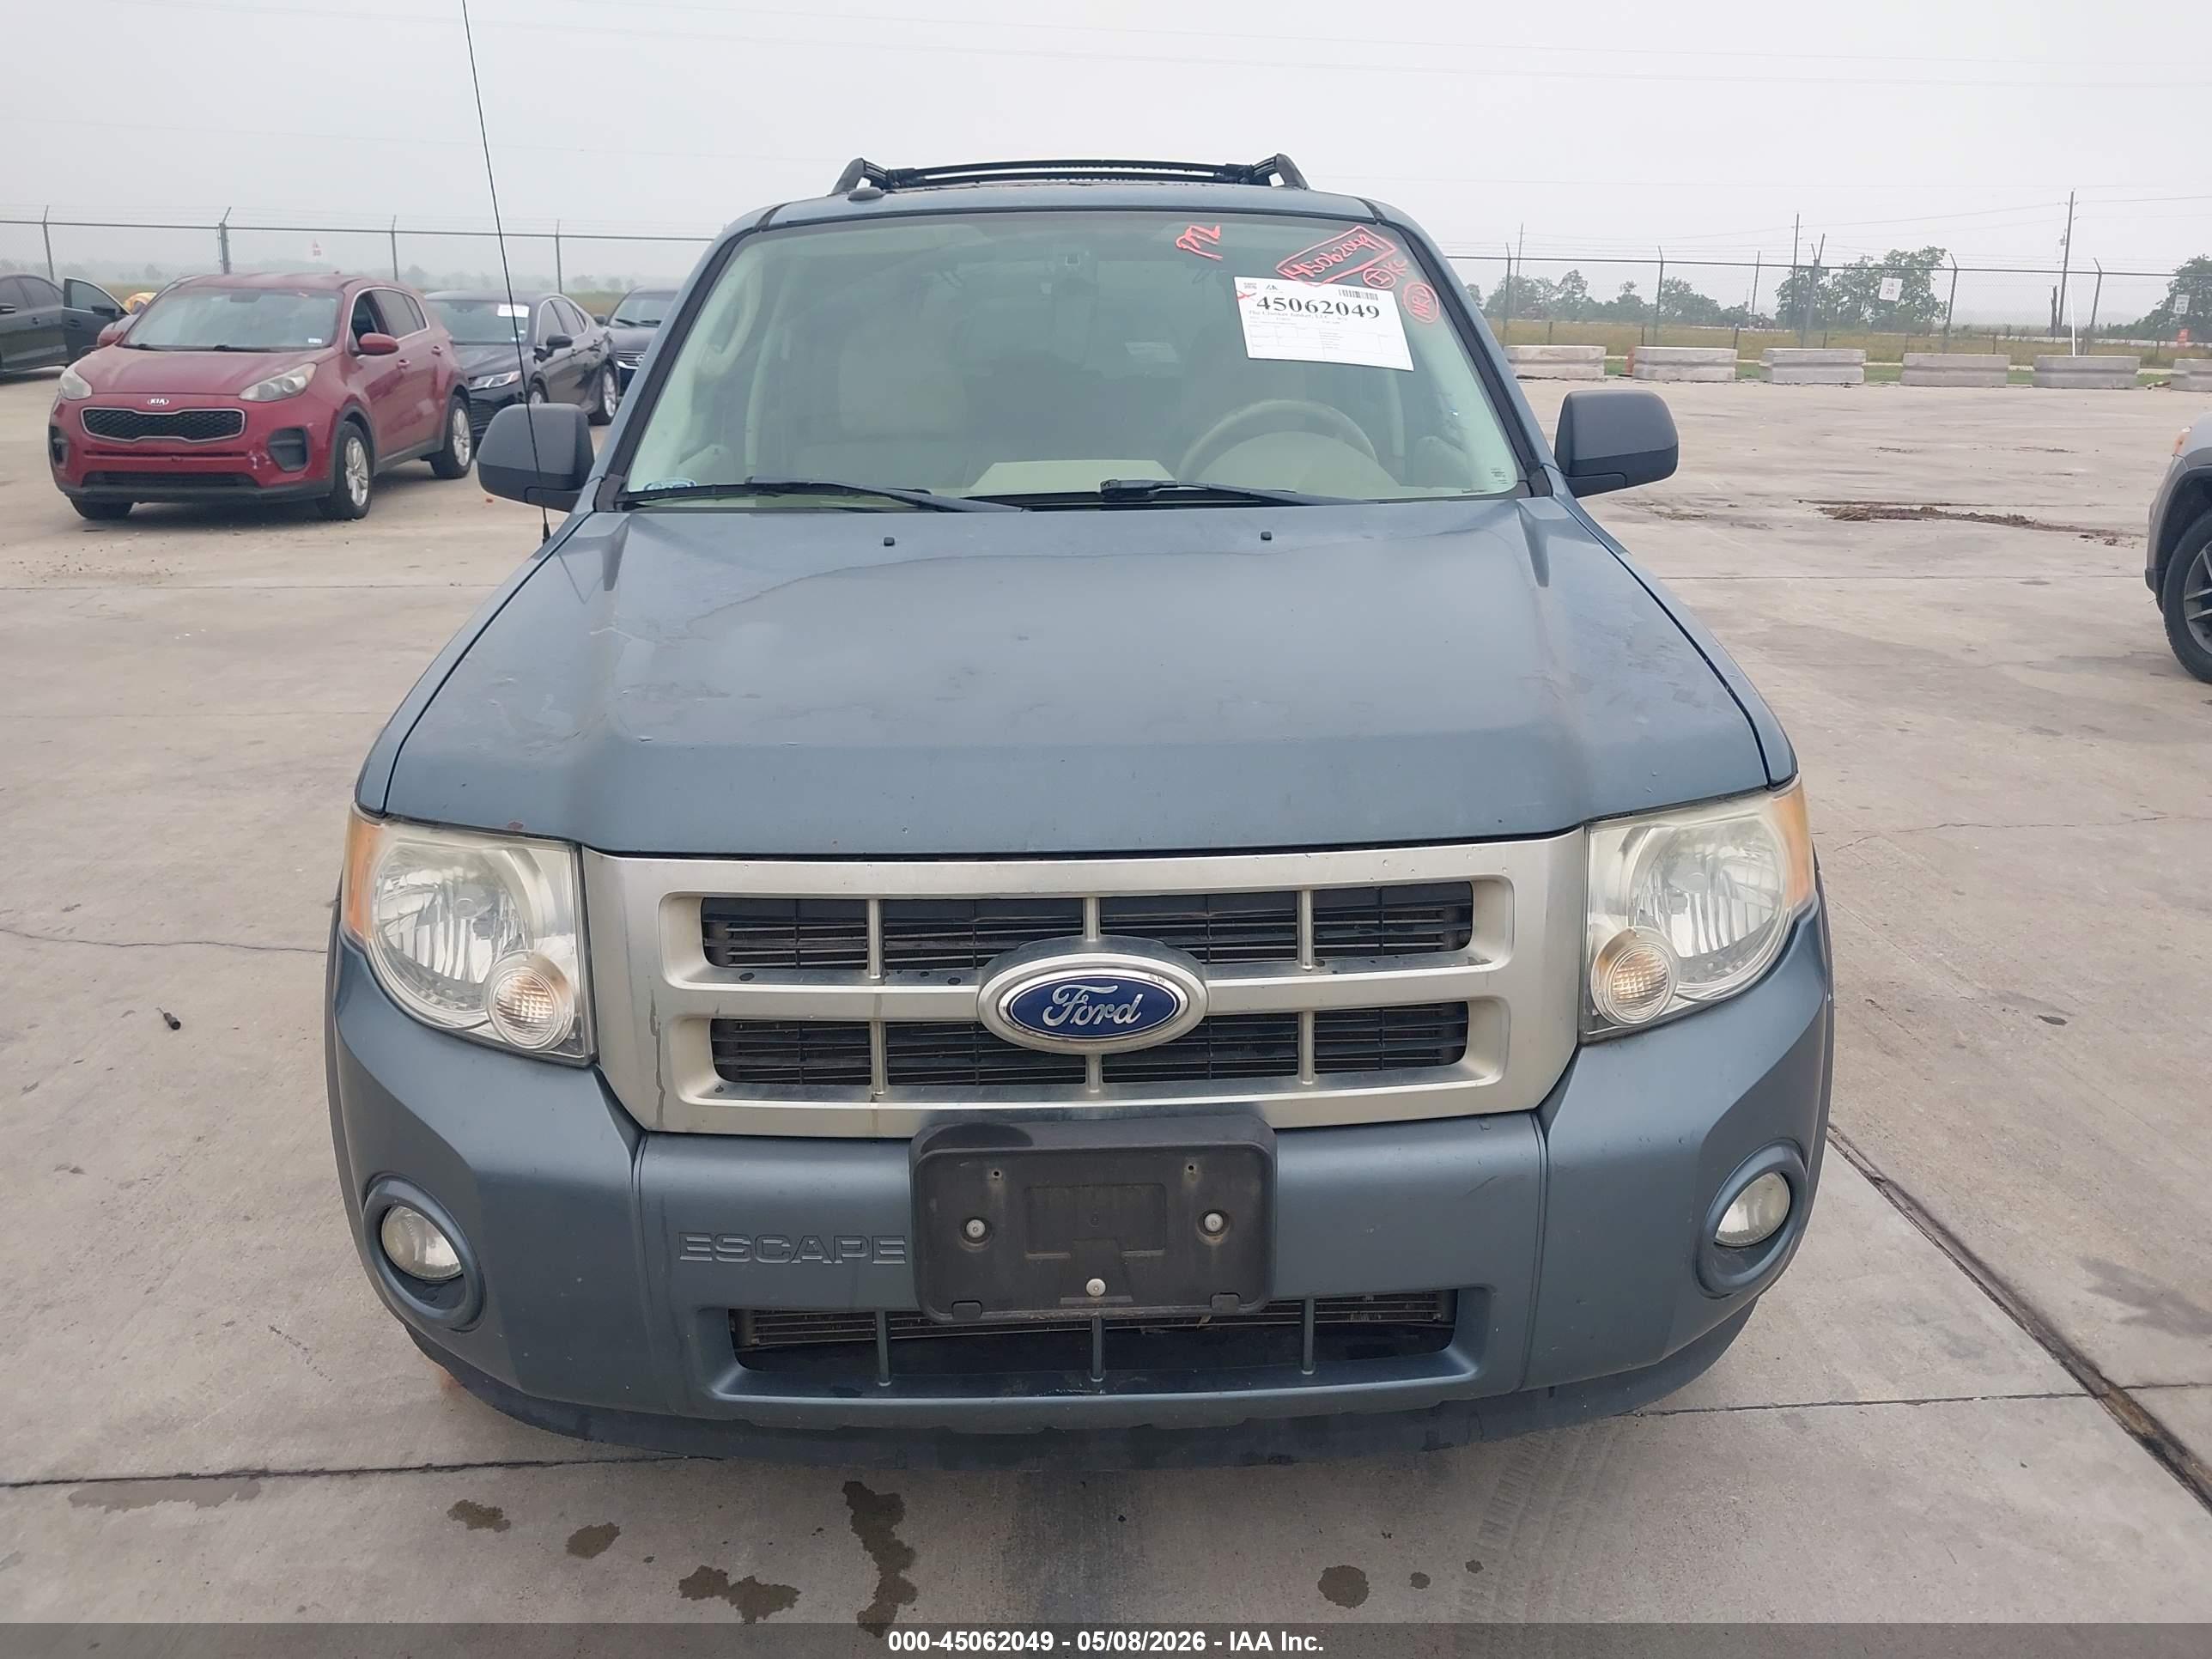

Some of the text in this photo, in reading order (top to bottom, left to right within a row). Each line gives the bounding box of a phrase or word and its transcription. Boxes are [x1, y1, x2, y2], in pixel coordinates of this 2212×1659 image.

[1284, 234, 1384, 277] 45062049
[1256, 296, 1381, 319] 45062049
[1042, 983, 1144, 1027] Ford
[678, 1231, 906, 1264] ESCAPE
